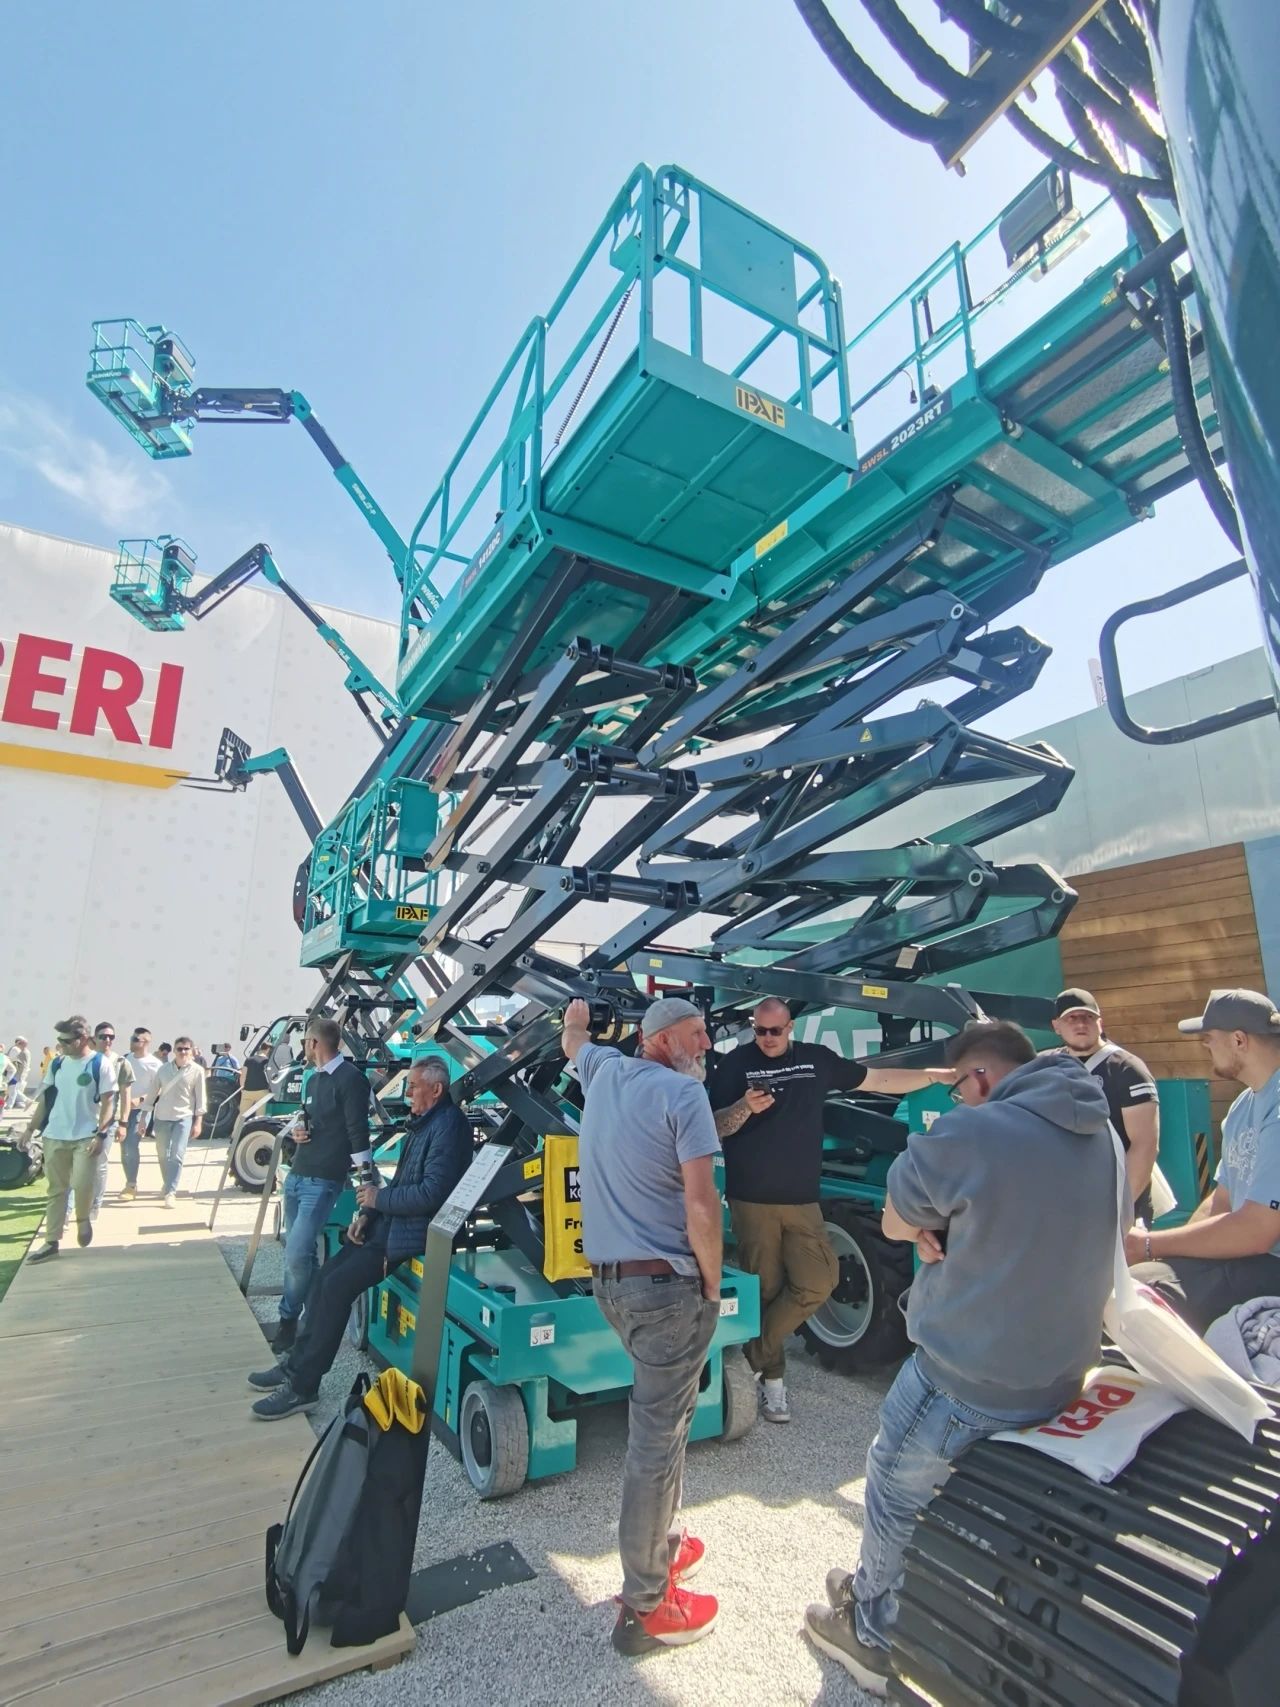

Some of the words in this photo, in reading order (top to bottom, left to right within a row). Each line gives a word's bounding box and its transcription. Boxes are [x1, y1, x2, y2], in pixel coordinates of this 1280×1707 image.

[737, 388, 784, 424] IPAF
[861, 447, 889, 473] SWSL
[890, 400, 944, 451] 2023RT
[0, 633, 184, 749] ERI
[397, 905, 428, 920] IPAF
